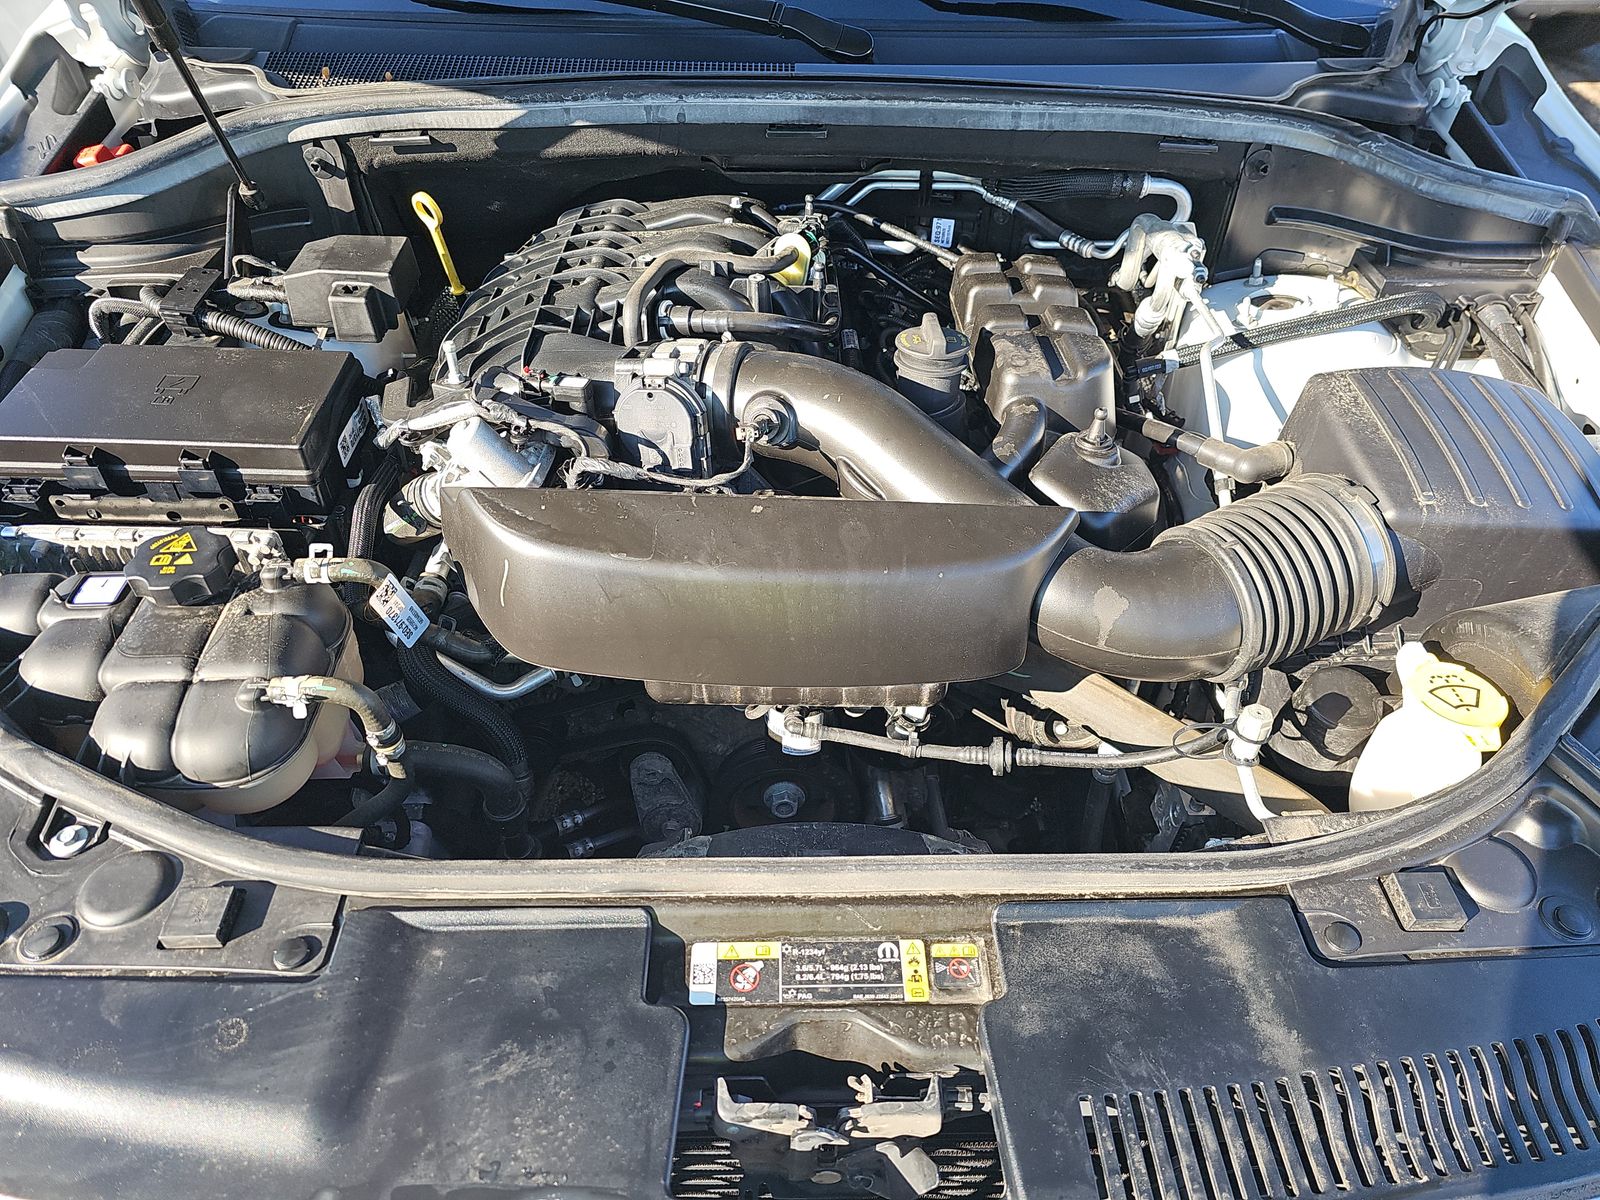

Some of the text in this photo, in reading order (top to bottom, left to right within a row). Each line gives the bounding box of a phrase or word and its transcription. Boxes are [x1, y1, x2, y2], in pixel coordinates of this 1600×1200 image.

[792, 948, 826, 957] R-1234yf
[795, 964, 825, 972] 3.6/5.7L
[850, 963, 868, 972] (2.13
[869, 963, 884, 972] lbs)
[795, 973, 826, 981] 6.2/6.4L
[831, 973, 850, 982] 794g
[850, 972, 869, 982] (1.75
[869, 972, 885, 982] lbs)
